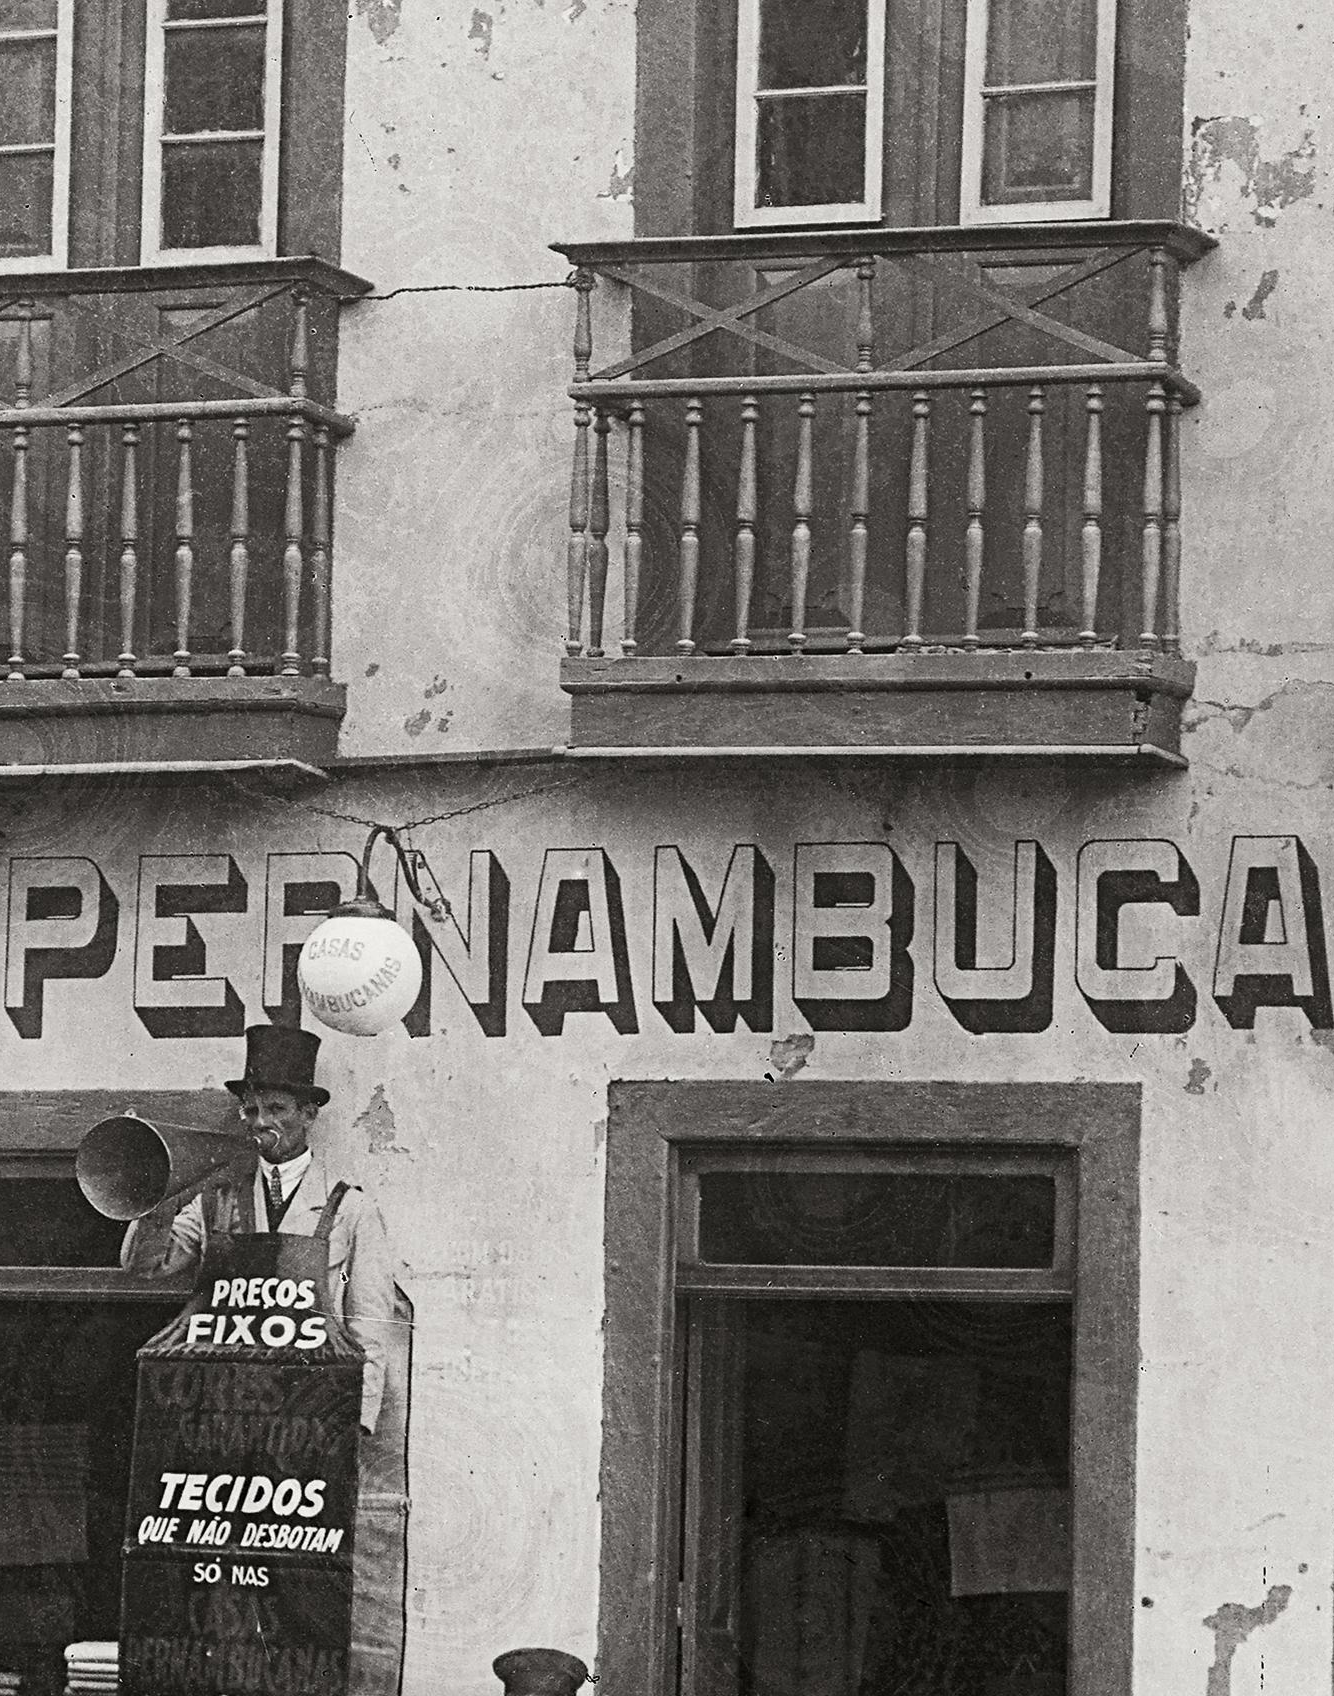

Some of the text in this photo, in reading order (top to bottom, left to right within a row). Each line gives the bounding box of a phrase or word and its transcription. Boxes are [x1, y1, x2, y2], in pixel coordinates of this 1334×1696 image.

[308, 937, 365, 961] CASAS
[211, 1277, 315, 1309] PREÇOS
[185, 1313, 328, 1350] FIXOS
[158, 1472, 327, 1518] TECIDOS
[138, 1514, 344, 1553] QUE NÃO DESBOTAM
[192, 1555, 270, 1588] SÓ NAS
